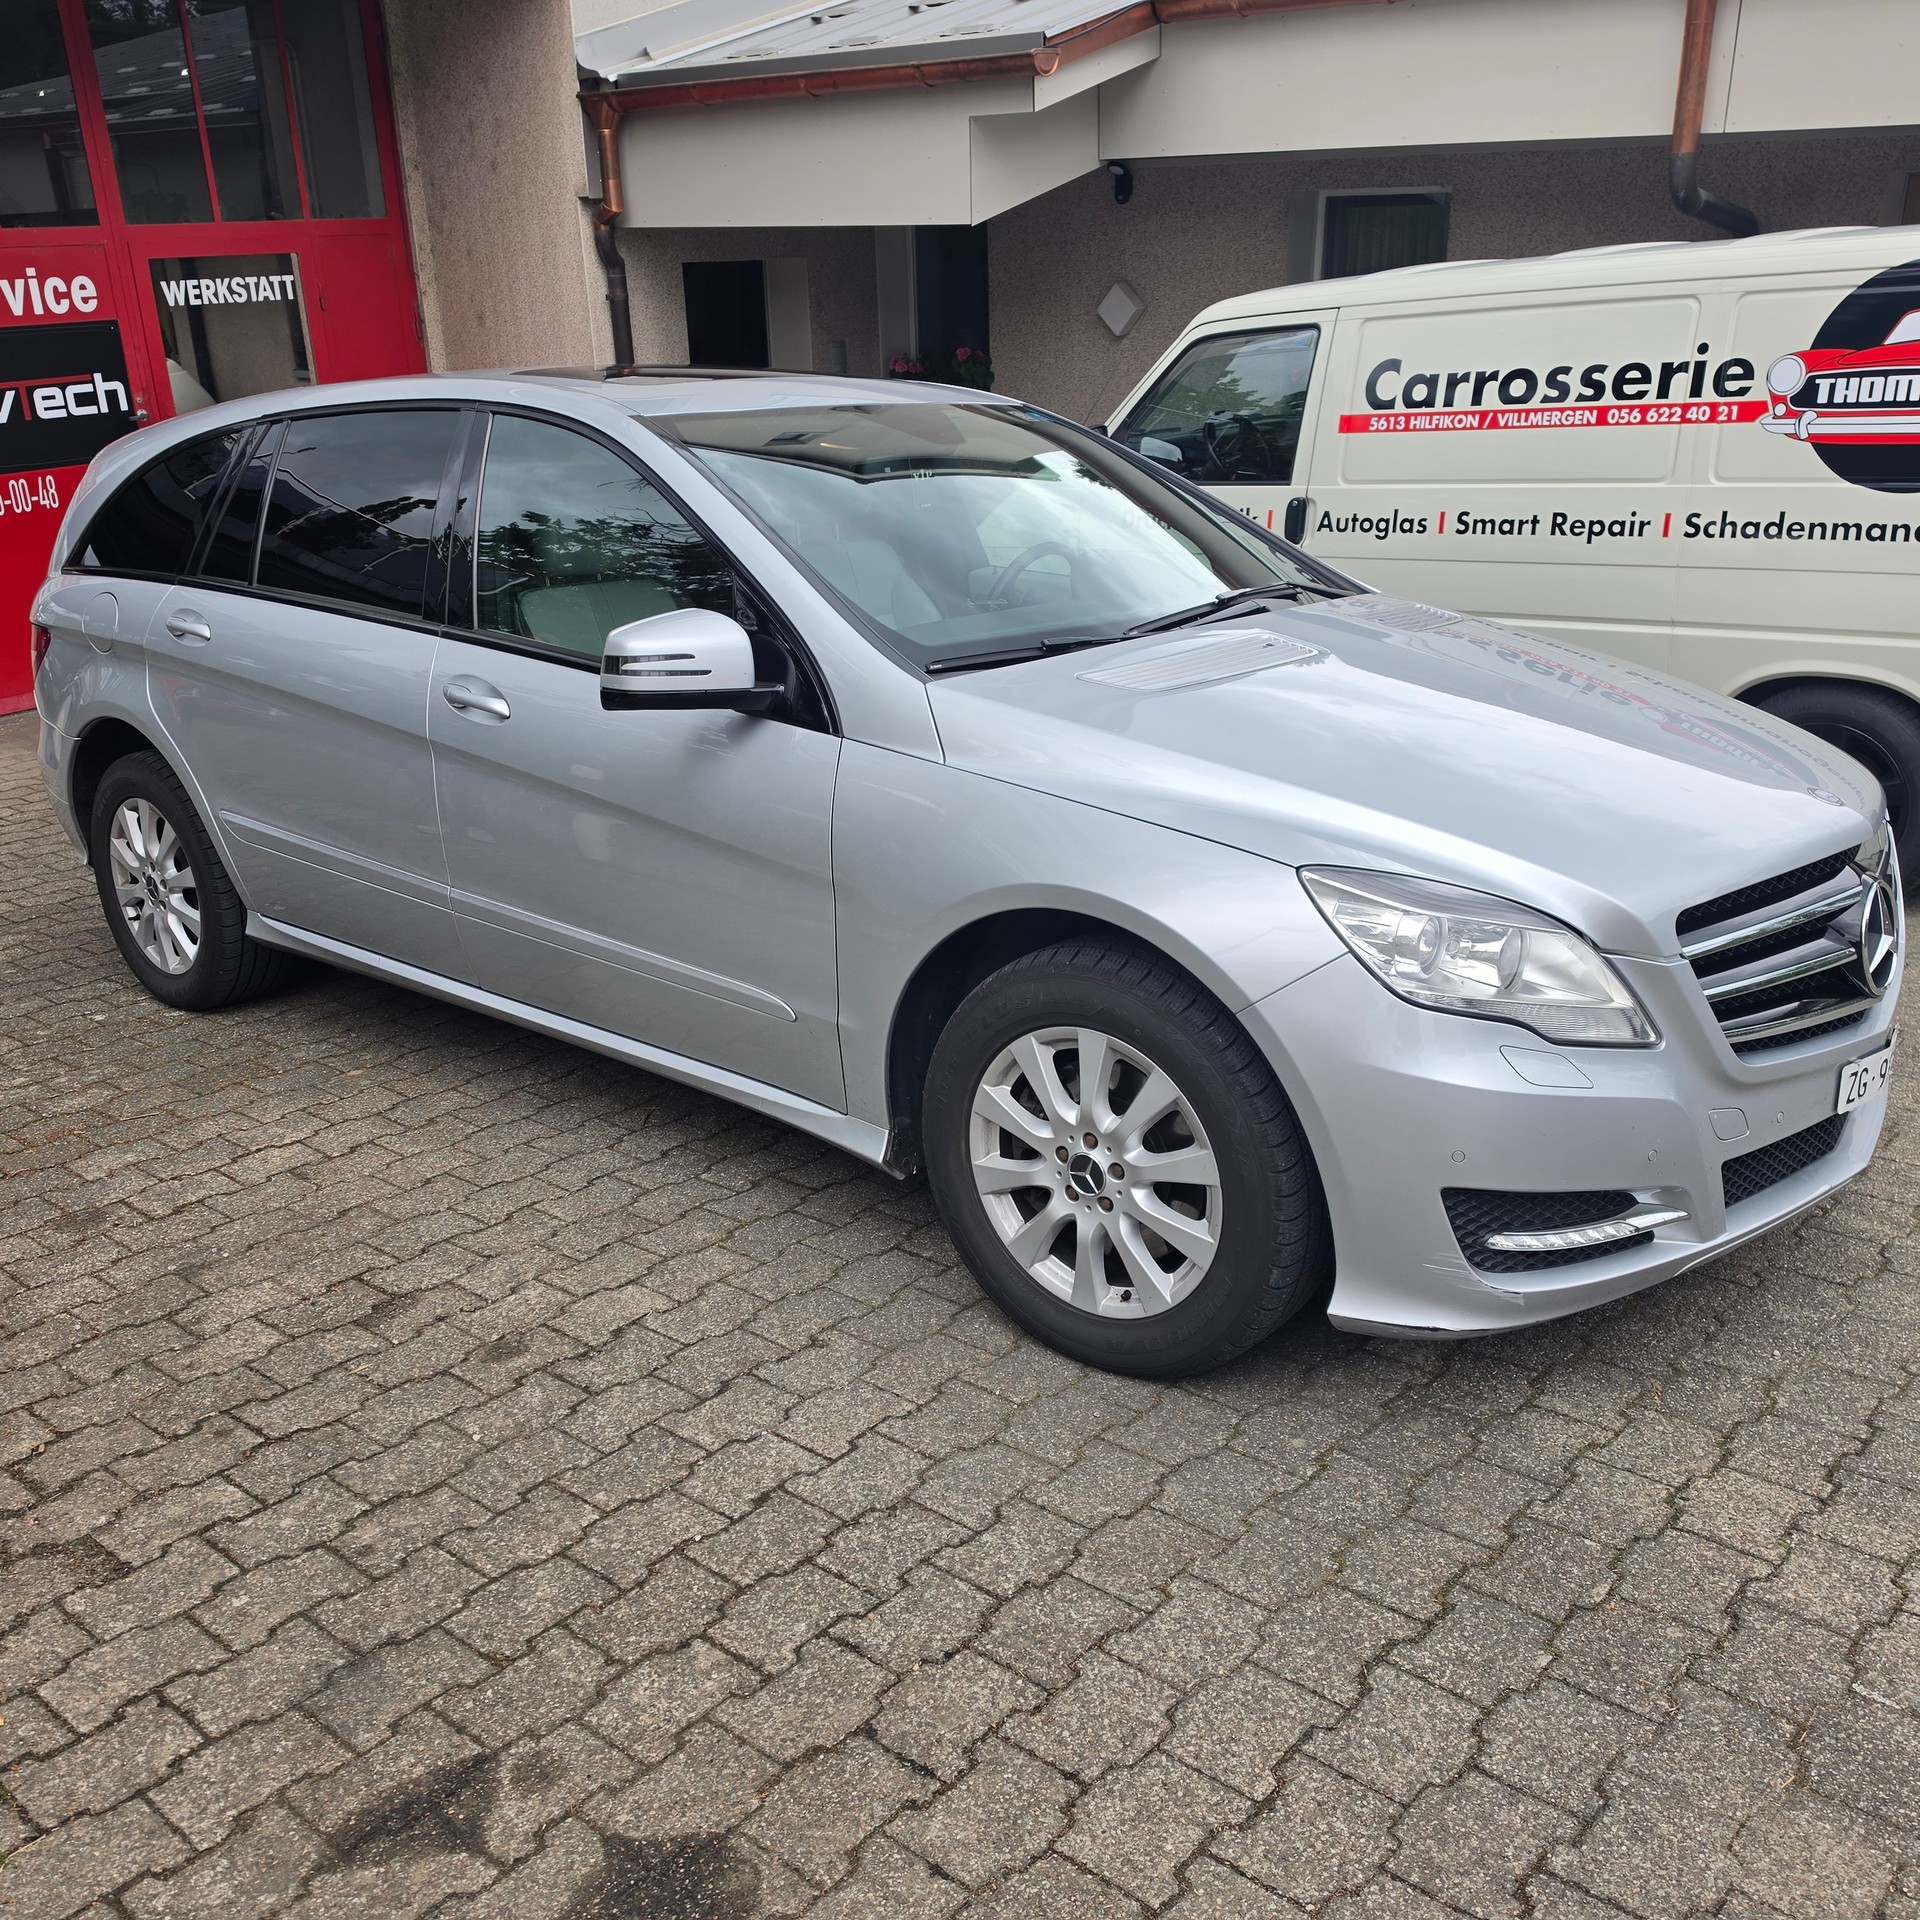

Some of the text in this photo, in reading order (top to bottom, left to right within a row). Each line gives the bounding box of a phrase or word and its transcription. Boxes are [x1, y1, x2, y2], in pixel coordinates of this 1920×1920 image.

[160, 274, 294, 306] WERKSTATT
[1365, 342, 1755, 410] Carrosserie
[1368, 416, 1405, 431] 5613
[1408, 413, 1479, 430] HILFIKON
[1496, 409, 1598, 427] VILLMERGEN
[1606, 408, 1641, 424] 056
[1645, 407, 1681, 423] 622
[1685, 406, 1711, 422] 40
[1717, 405, 1739, 421] 21
[1317, 508, 1920, 544] Autoglas Smart Repair Schadenman
[1846, 1067, 1869, 1105] ZG
